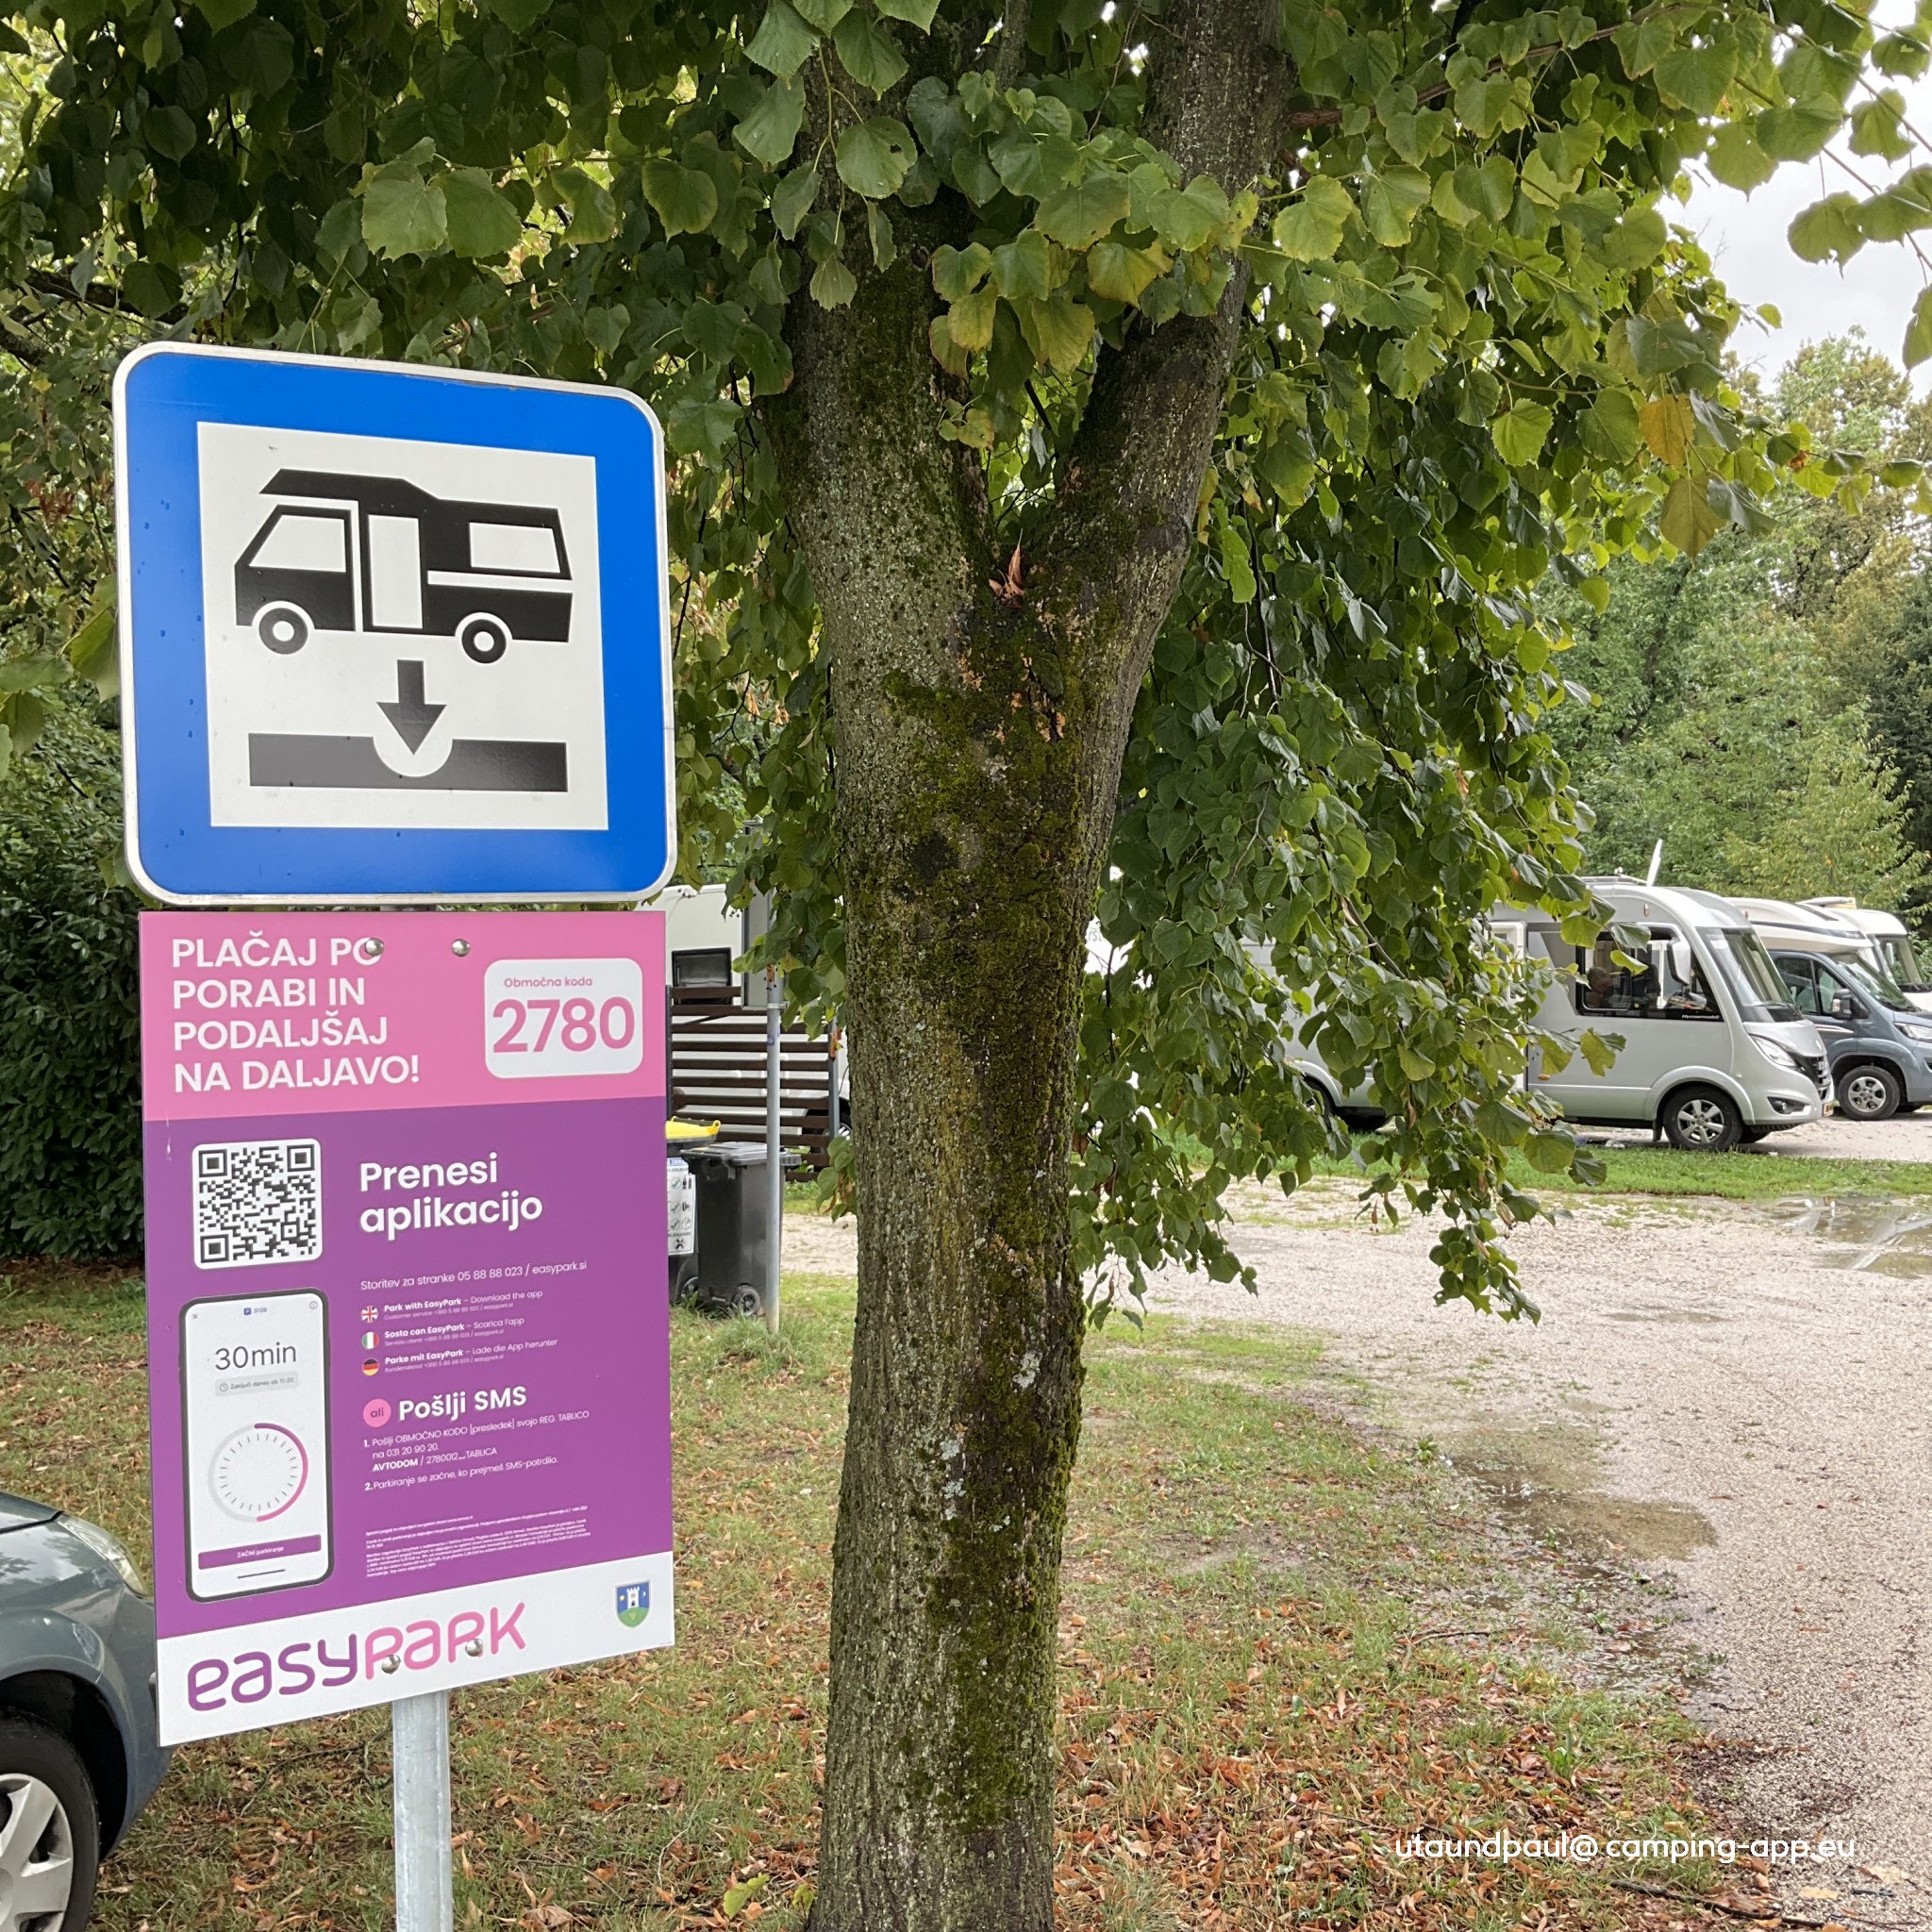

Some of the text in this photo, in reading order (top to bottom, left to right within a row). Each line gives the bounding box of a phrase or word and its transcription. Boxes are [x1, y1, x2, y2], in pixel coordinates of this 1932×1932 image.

[173, 930, 317, 968] PLAČAJ
[174, 977, 365, 1009] PORABI IN
[504, 975, 592, 989] Območna koda
[174, 1009, 388, 1051] PODALJŠAJ
[492, 996, 636, 1054] 2780
[175, 1055, 420, 1092] NA DALJAVO!
[360, 1152, 497, 1192] Prenesi
[359, 1190, 543, 1241] aplikacijo
[360, 1278, 400, 1291] Storitev
[402, 1277, 415, 1287] za
[417, 1273, 455, 1285] stranke
[458, 1271, 472, 1281] 05
[473, 1269, 487, 1280] 88
[489, 1268, 503, 1278] 88
[505, 1266, 523, 1277] 023
[532, 1260, 587, 1274] easypark.si
[384, 1303, 403, 1312] Park
[405, 1301, 423, 1310] with
[425, 1297, 462, 1308] EasyPark
[471, 1292, 511, 1304] Download
[526, 1291, 543, 1299] app
[384, 1329, 408, 1339] Sosta
[427, 1323, 465, 1335] EasyPark
[474, 1319, 504, 1329] Scarica
[214, 1341, 297, 1372] 30min
[385, 1355, 408, 1365] Parke
[410, 1353, 425, 1362] mit
[425, 1348, 464, 1360] EasyPark
[473, 1345, 491, 1355] Lade
[492, 1343, 507, 1353] die
[507, 1342, 525, 1352] App
[525, 1339, 558, 1348] herunter
[370, 1407, 385, 1418] ali
[399, 1386, 527, 1422] Pošlji SMS
[363, 1439, 371, 1448] 1.
[372, 1435, 393, 1446] Pošlji
[395, 1429, 442, 1443] OBMOČNO
[443, 1426, 468, 1437] KODO
[516, 1417, 539, 1427] svojo
[539, 1415, 557, 1424] REG.
[558, 1410, 590, 1422] TABLICO
[372, 1450, 385, 1459] na
[386, 1447, 400, 1457] 031
[401, 1445, 413, 1456] 20
[413, 1443, 426, 1454] 90
[373, 1457, 419, 1472] AVTODOM
[364, 1482, 374, 1491] 2.
[374, 1475, 416, 1491] Parkiranje
[417, 1474, 427, 1484] se
[458, 1469, 469, 1477] ko
[470, 1464, 505, 1478] prejmeš
